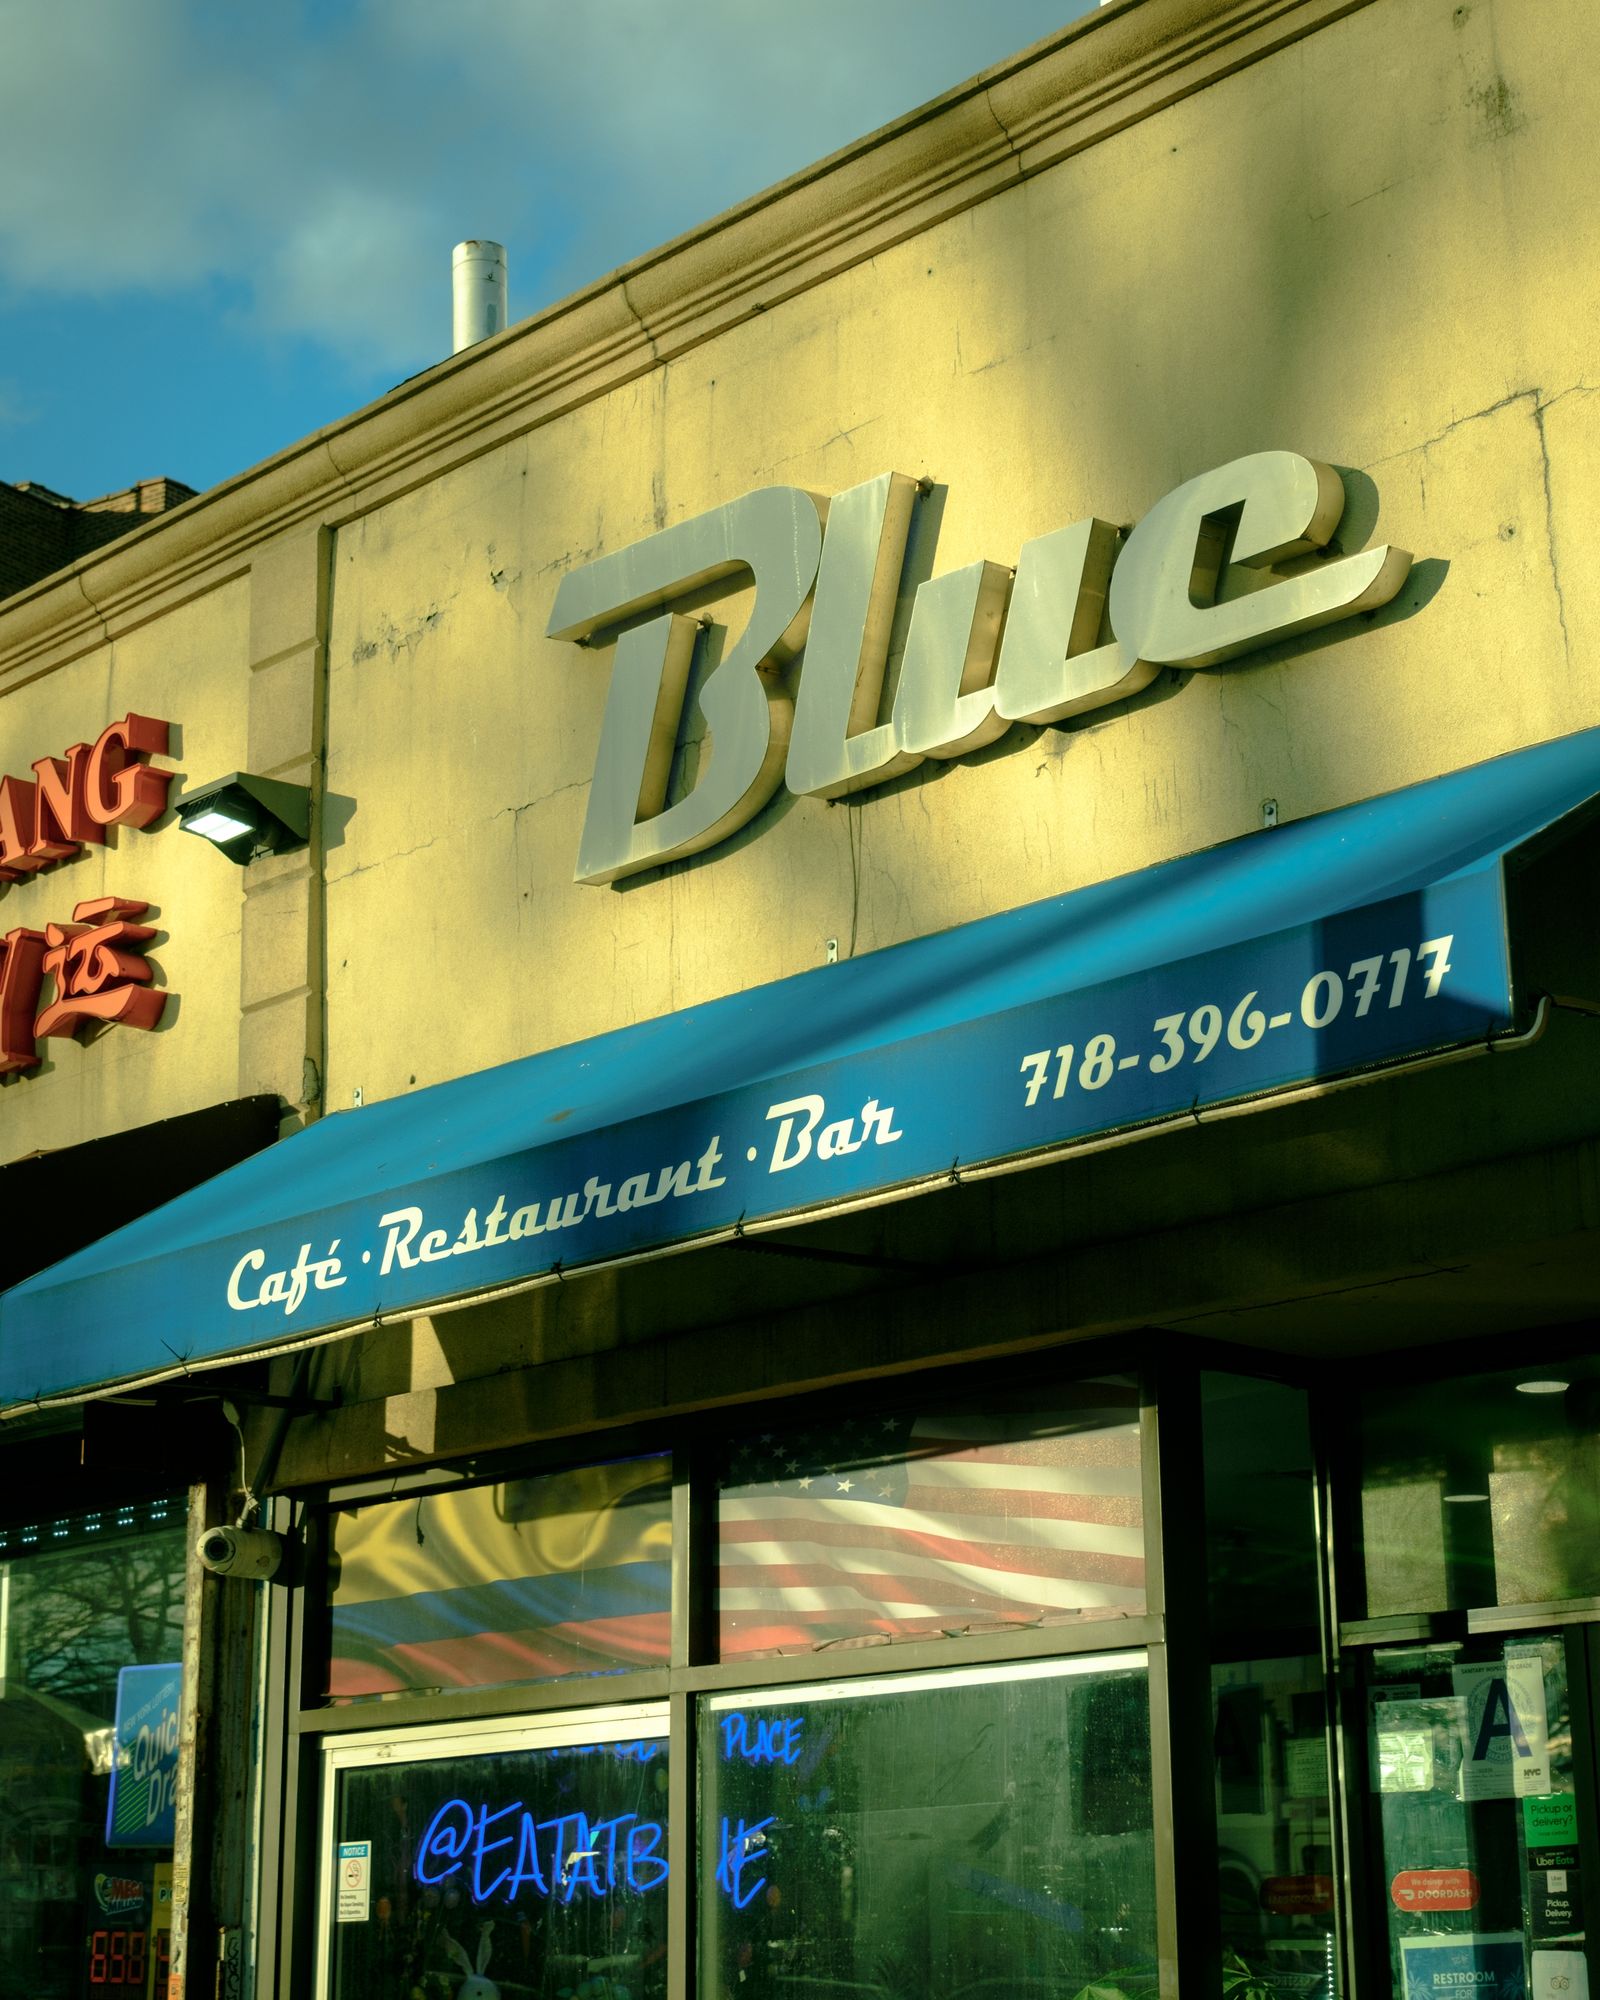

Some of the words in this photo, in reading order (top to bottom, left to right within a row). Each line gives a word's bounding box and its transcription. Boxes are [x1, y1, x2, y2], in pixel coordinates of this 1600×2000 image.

[546, 450, 1412, 886] Blue
[1019, 934, 1455, 1107] 718-396-0717
[227, 1248, 348, 1315] Café
[378, 1135, 727, 1276] Restaurant
[765, 1093, 903, 1174] Bar
[1472, 1678, 1534, 1762] A
[719, 1712, 804, 1765] PLACE
[1523, 1768, 1542, 1777] NYC
[1530, 1804, 1561, 1815] Pickup
[1562, 1804, 1573, 1813] or
[1532, 1814, 1574, 1828] delivery?
[342, 1846, 366, 1857] NOTICE
[1536, 1857, 1555, 1866] Uber
[1555, 1856, 1575, 1865] Eats
[1417, 1888, 1473, 1899] DOORDASH
[1432, 1970, 1496, 1985] RESTROOM
[1455, 1989, 1473, 1999] FOR
